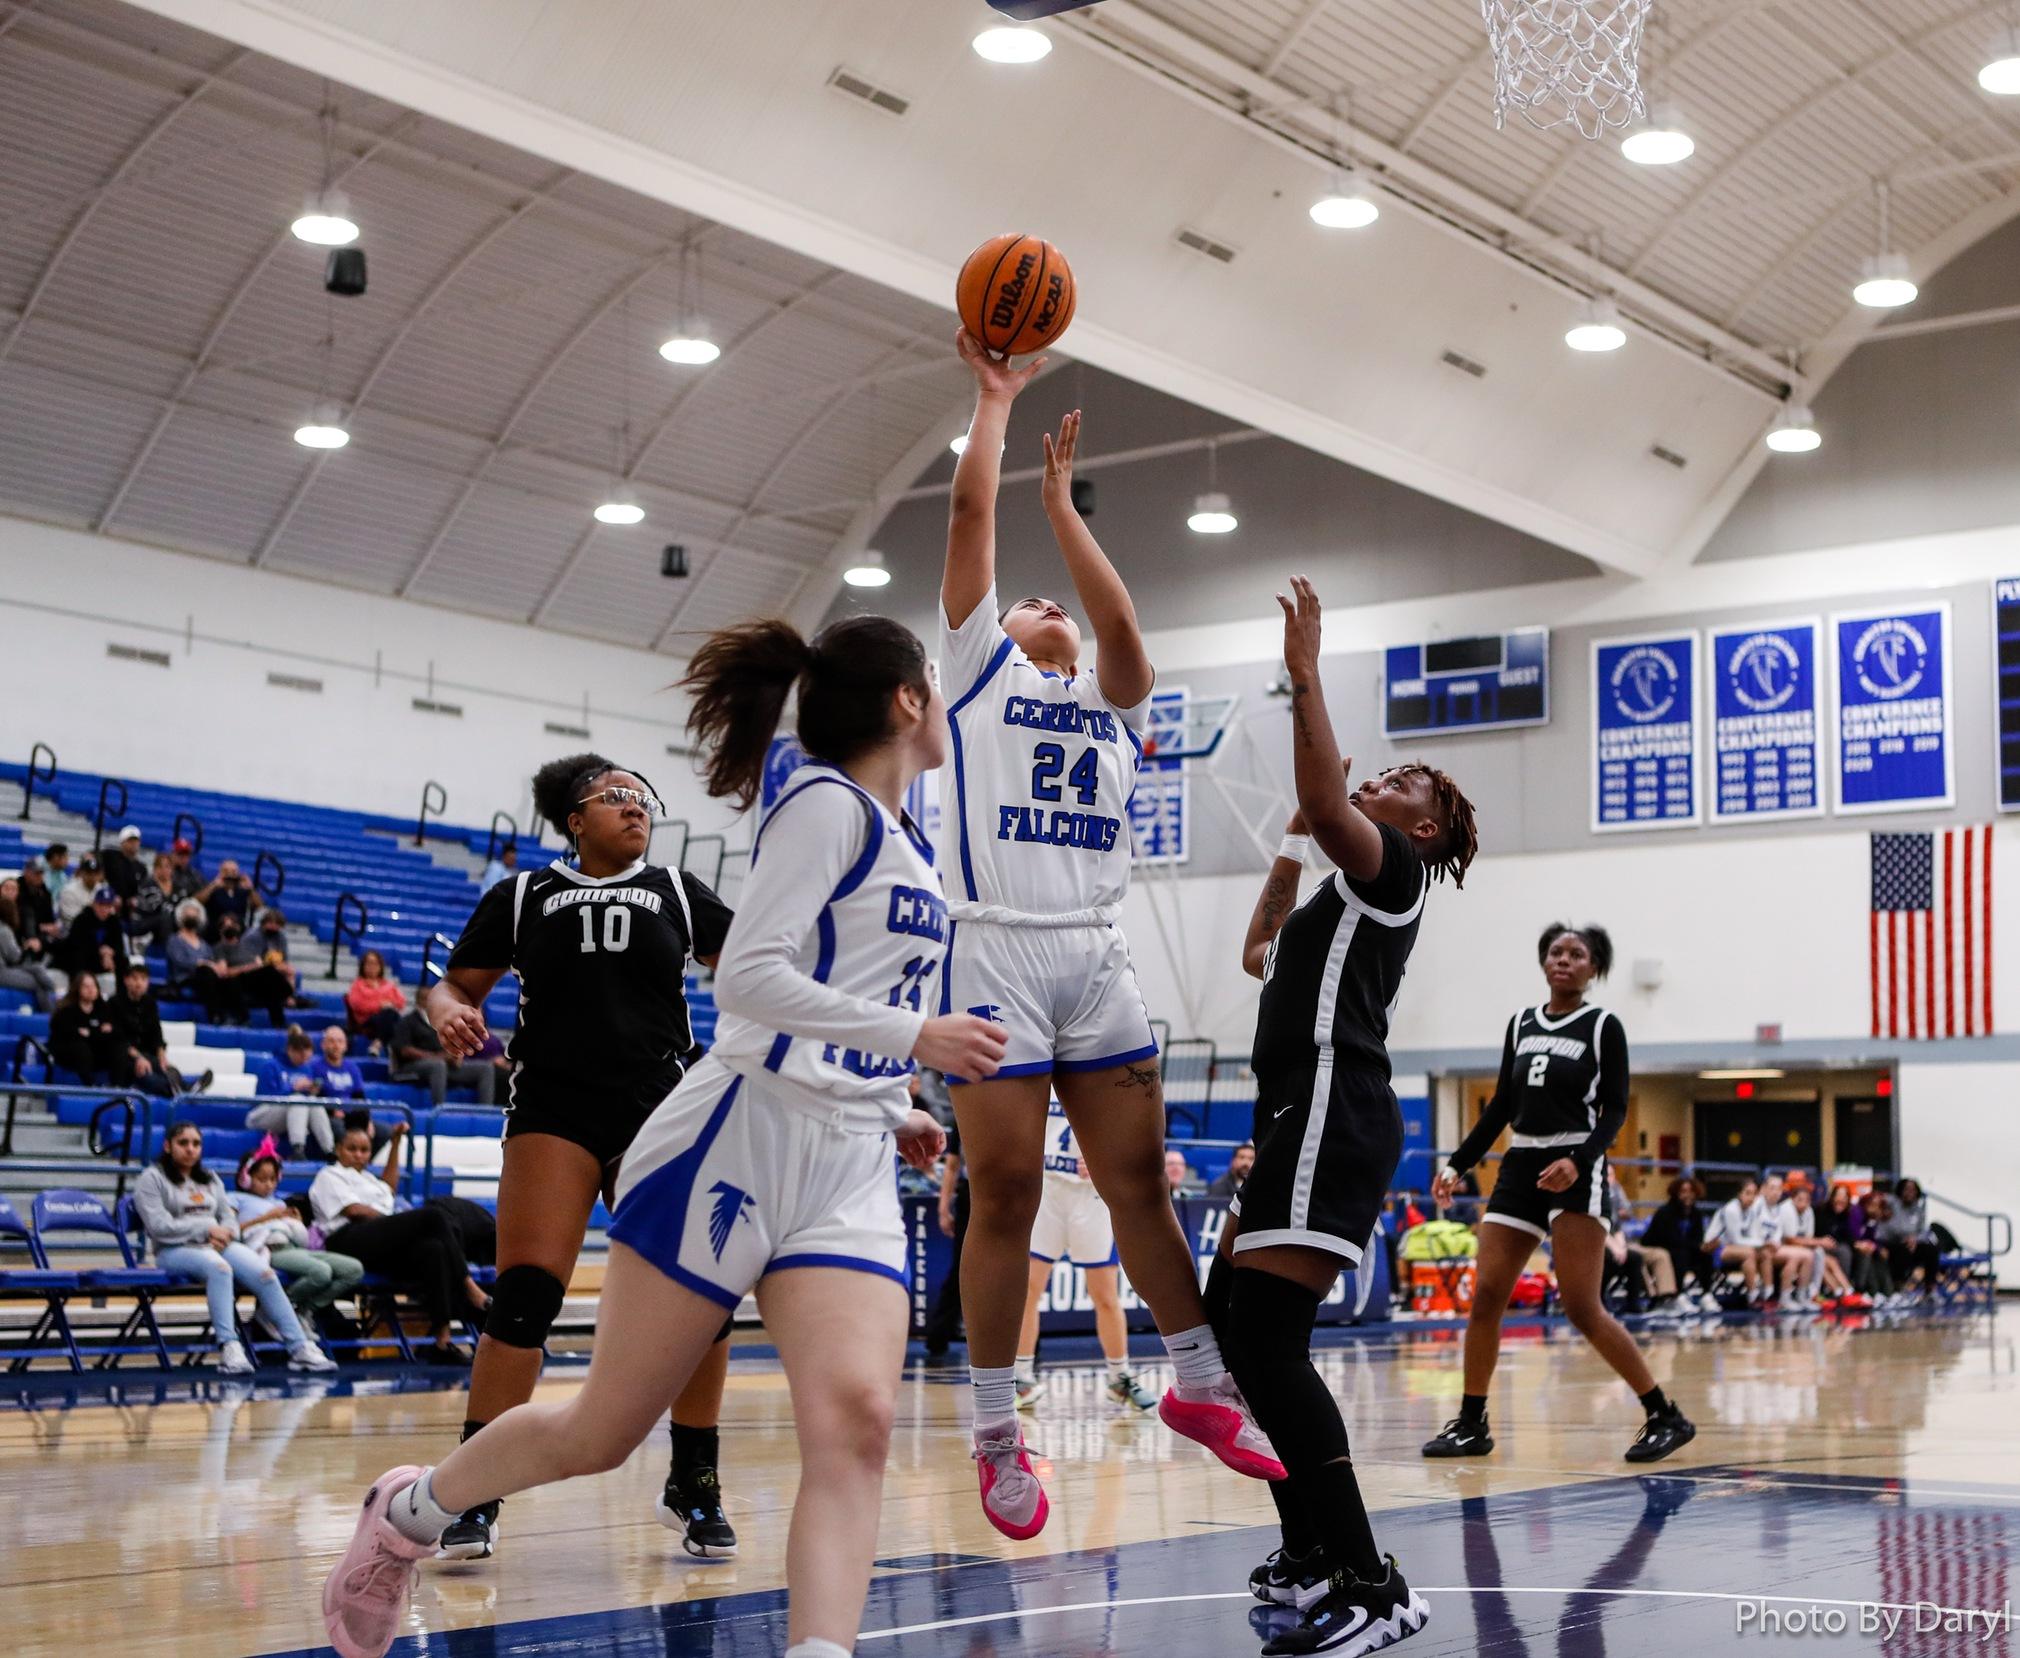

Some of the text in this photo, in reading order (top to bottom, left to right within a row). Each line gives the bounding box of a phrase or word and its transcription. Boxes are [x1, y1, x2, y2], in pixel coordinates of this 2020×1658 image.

[990, 254, 1036, 329] Wilson
[1033, 275, 1063, 333] NCAA
[1498, 667, 1539, 687] GUEST
[1718, 709, 1813, 734] CONFERENCE
[1842, 696, 1941, 722] CONFERENCE
[1600, 721, 1692, 746] CONFERENCE
[1718, 728, 1814, 752] CHAMPIONS
[1842, 716, 1942, 741] CHAMPIONS
[1600, 739, 1692, 762] CHAMPIONS
[1032, 742, 1098, 806] 24
[998, 805, 1120, 852] FALCONS
[543, 888, 662, 917] COMPTON
[579, 905, 632, 953] 10
[1527, 1054, 1549, 1087] 2
[1059, 1125, 1071, 1152] 4
[914, 1205, 928, 1328] FALCONS
